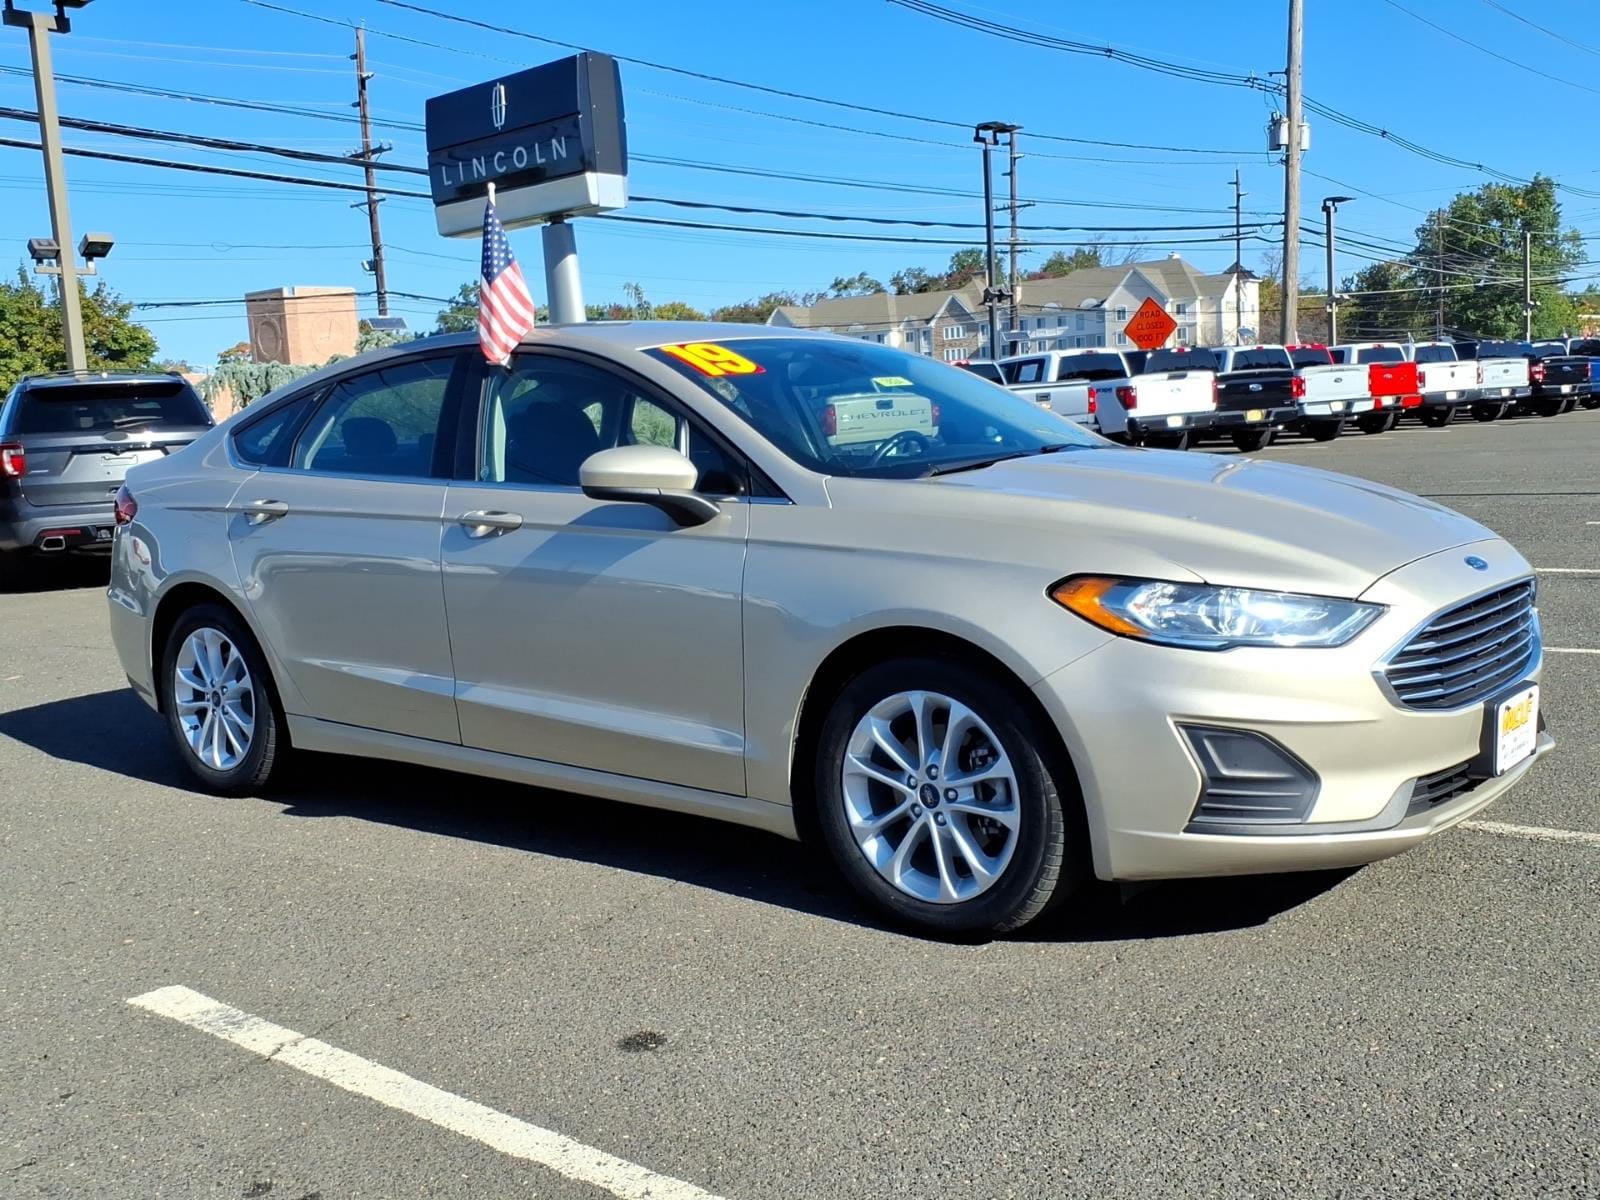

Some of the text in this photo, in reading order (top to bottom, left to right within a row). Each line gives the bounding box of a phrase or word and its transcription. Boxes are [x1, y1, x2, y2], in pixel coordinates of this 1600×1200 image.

[442, 136, 567, 186] LINCOLN
[1139, 310, 1161, 319] ROAD
[1136, 321, 1165, 331] CLOSED
[658, 342, 760, 377] 19
[841, 409, 926, 421] CHEVROLET
